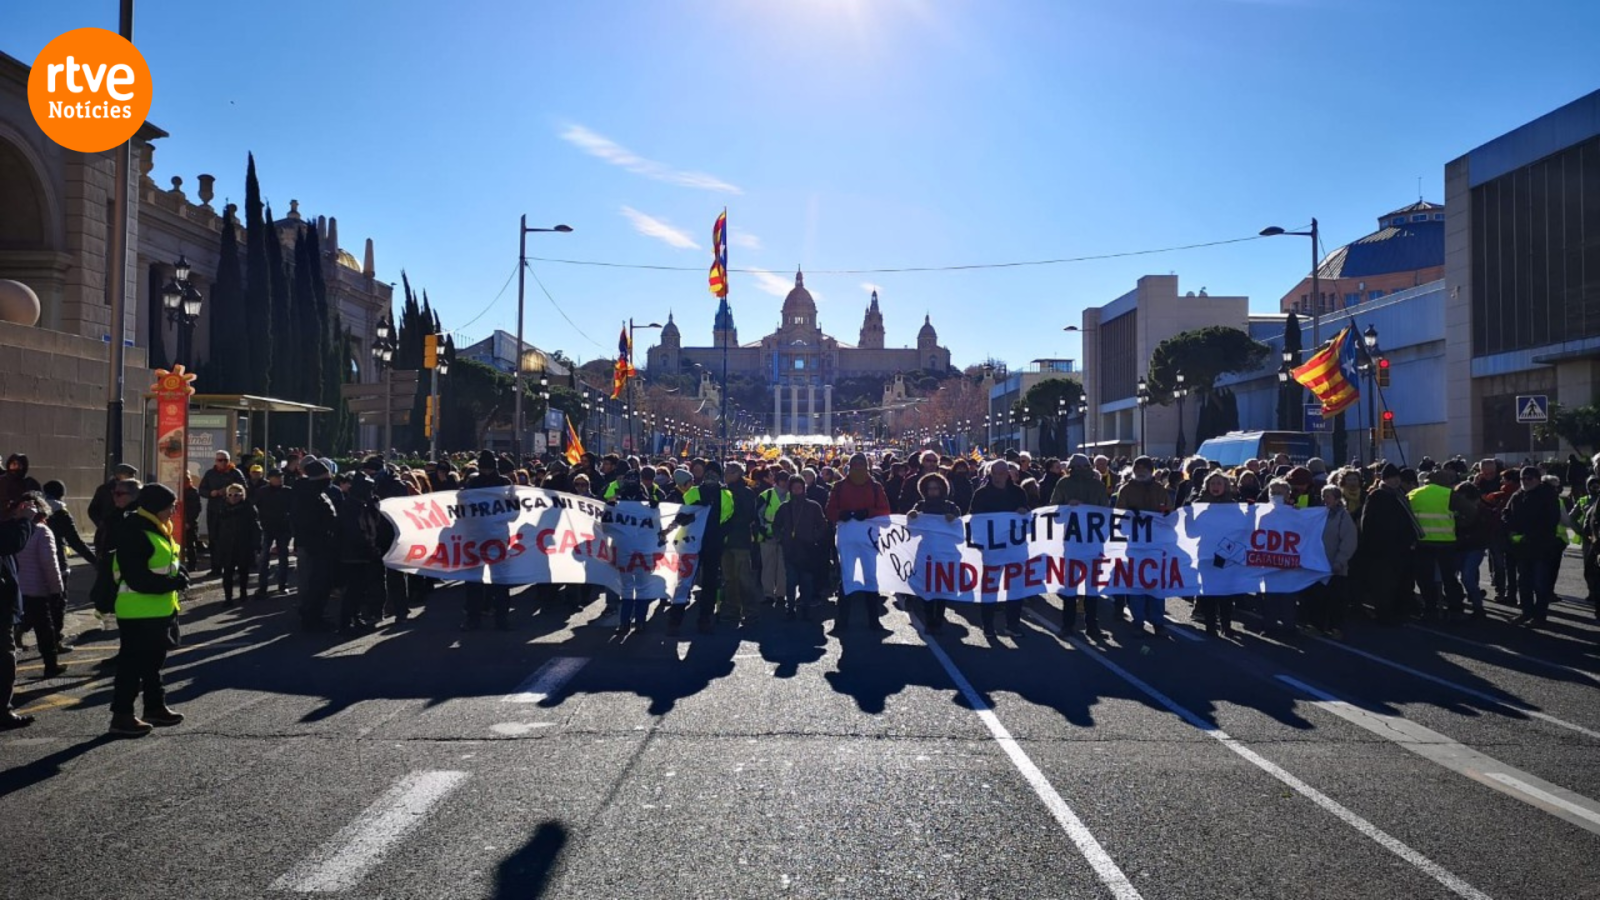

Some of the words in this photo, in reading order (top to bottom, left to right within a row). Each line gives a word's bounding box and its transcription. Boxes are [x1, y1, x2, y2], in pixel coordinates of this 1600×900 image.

[447, 504, 466, 519] NI
[469, 497, 548, 518] FRANÇA
[551, 495, 574, 510] NI
[964, 510, 1154, 550] LLUITAREM
[1250, 529, 1301, 554] CDR
[405, 533, 525, 569] PAÏSOS
[535, 529, 699, 578] CATALANS
[889, 553, 917, 582] la
